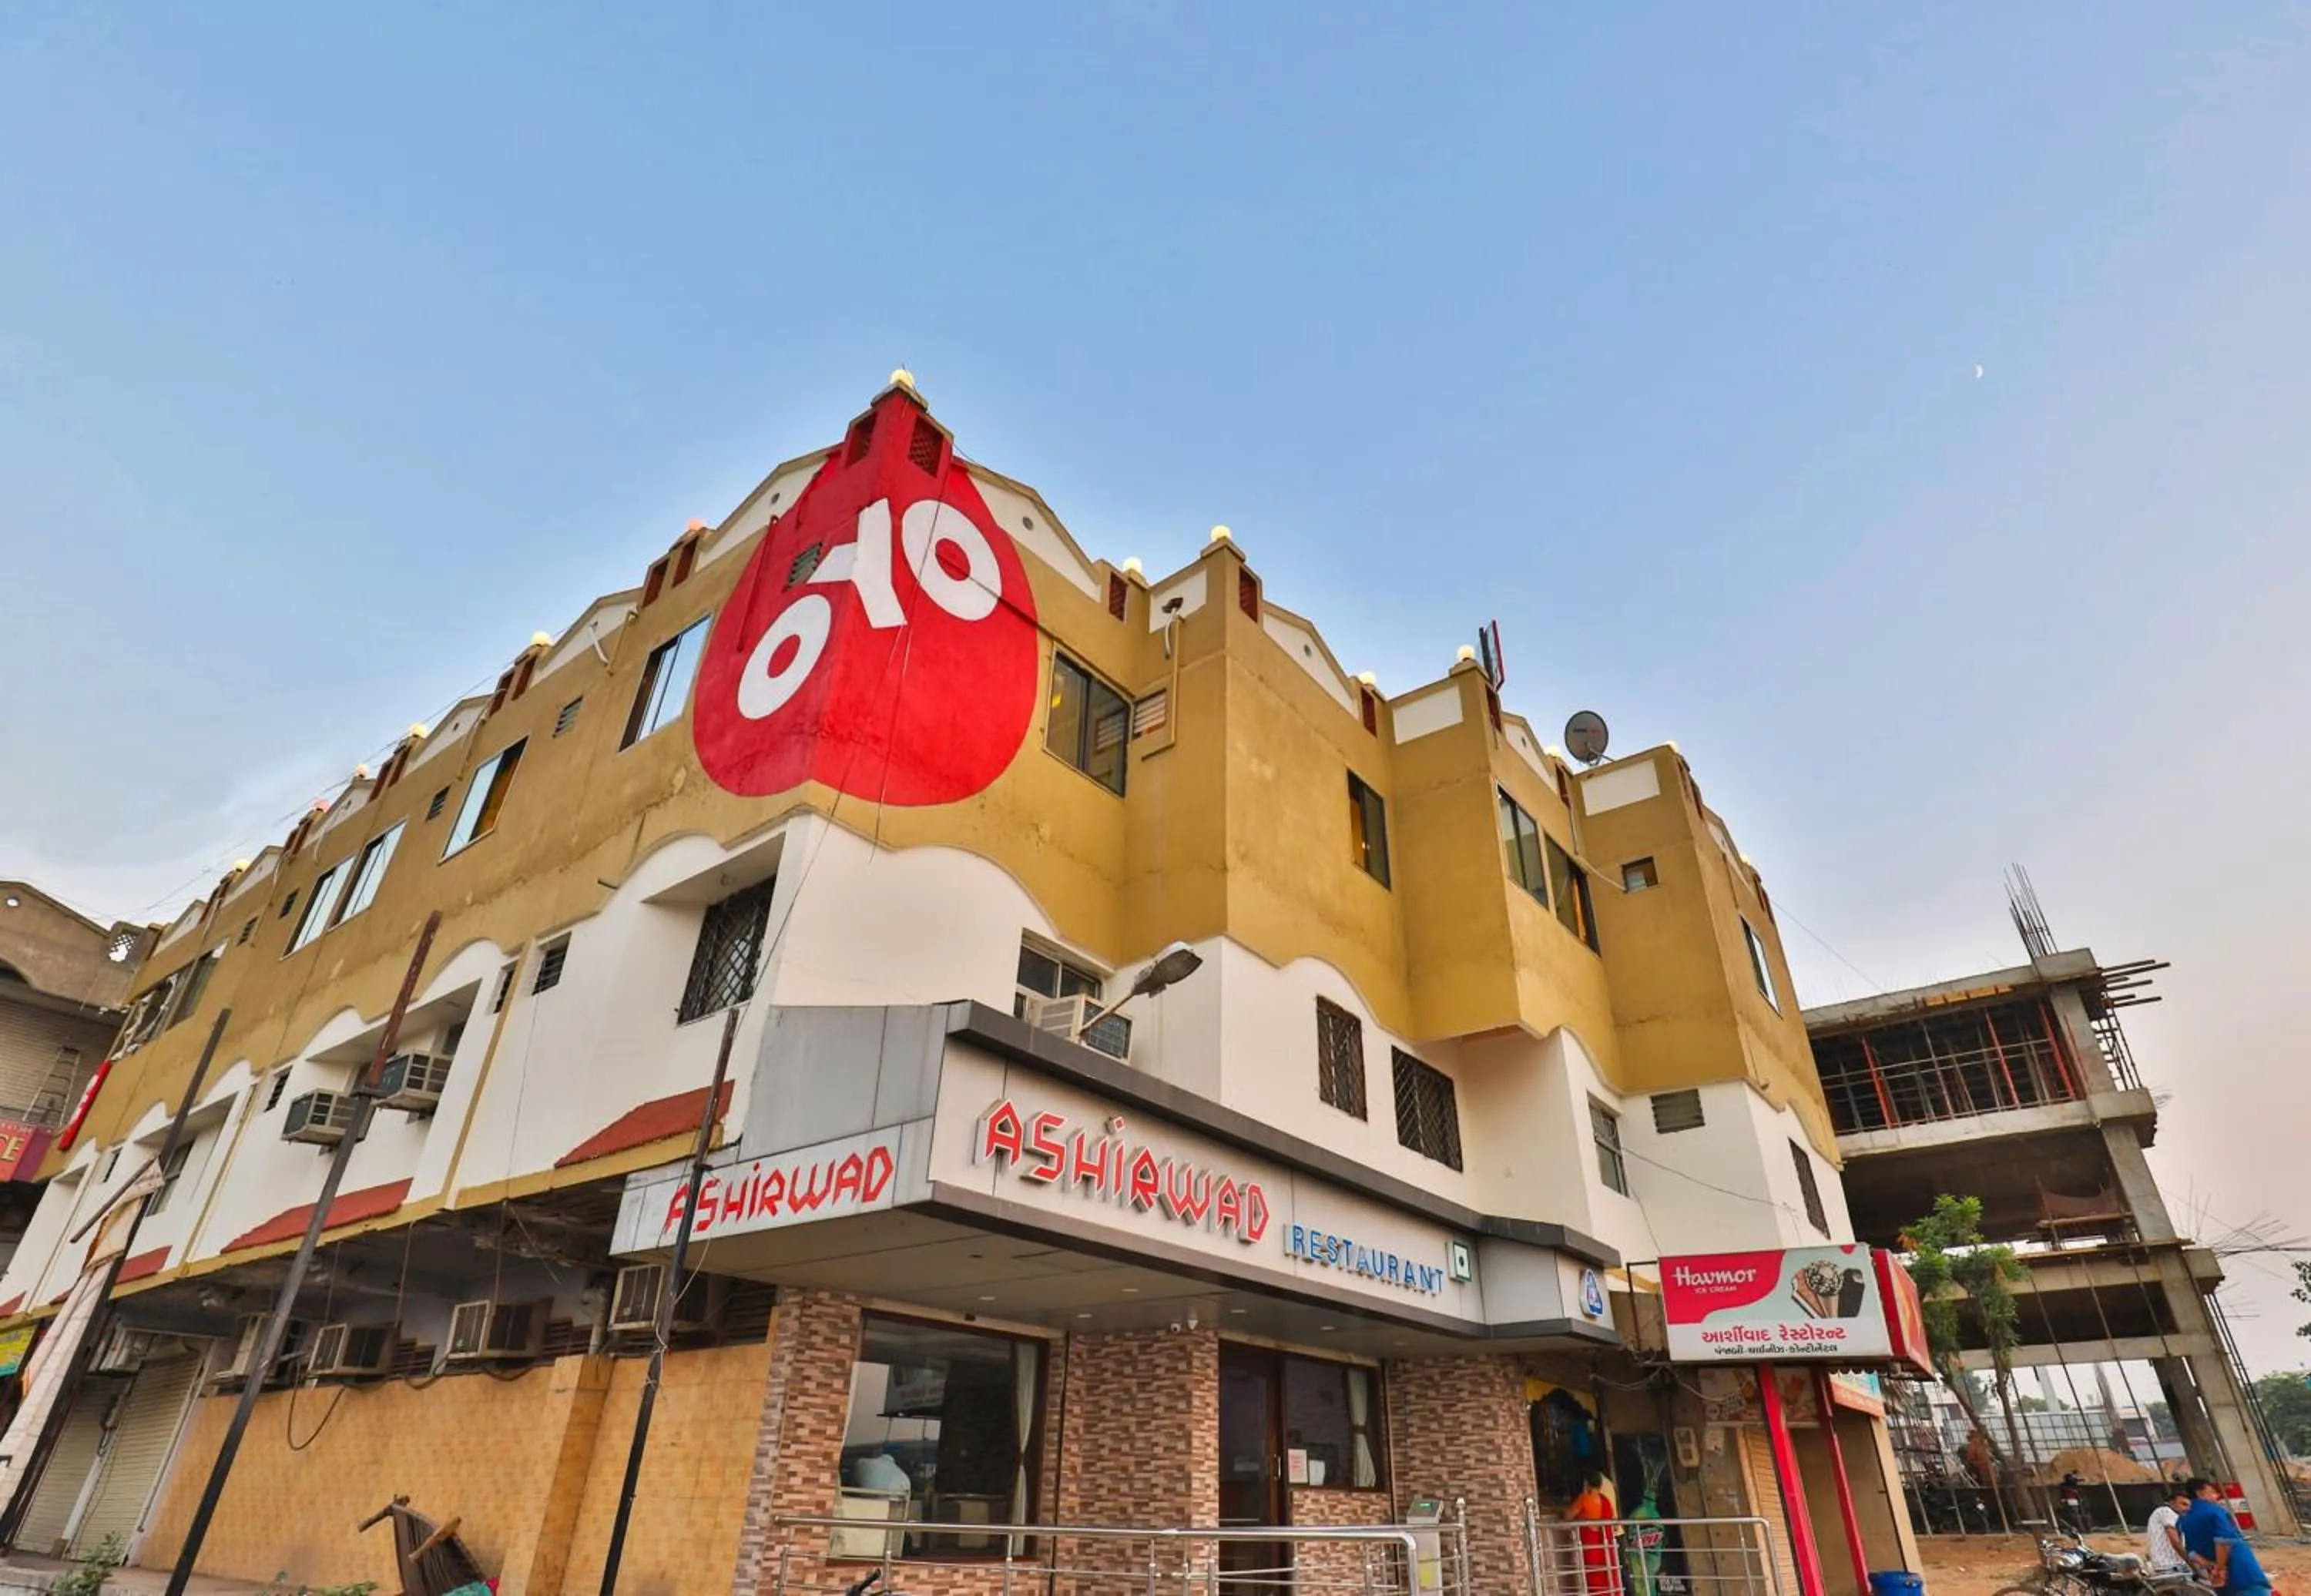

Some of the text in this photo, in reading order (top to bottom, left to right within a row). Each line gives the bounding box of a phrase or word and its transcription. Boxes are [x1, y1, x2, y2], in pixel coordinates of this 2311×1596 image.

[737, 497, 1002, 720] OYO
[1290, 1222, 1444, 1293] RESTAURANT
[1671, 1266, 1757, 1287] Havmor
